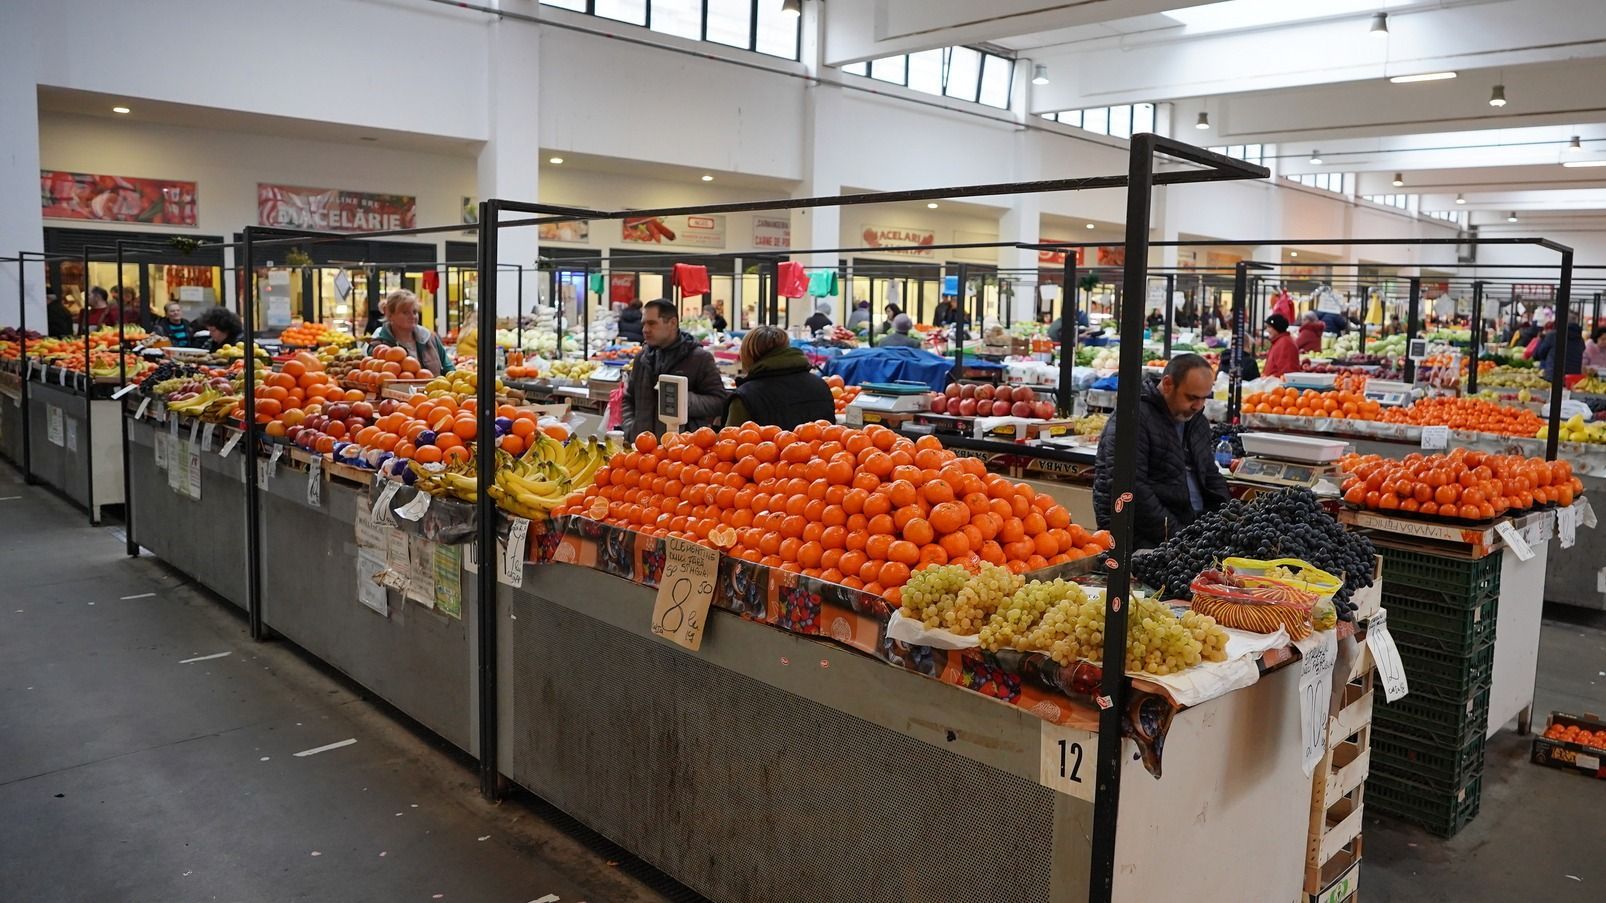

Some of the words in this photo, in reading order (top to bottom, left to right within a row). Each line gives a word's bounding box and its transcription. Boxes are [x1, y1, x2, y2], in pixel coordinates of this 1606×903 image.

[1038, 460, 1079, 474] SAMBA
[661, 578, 693, 634] 8
[697, 580, 713, 595] 50
[1057, 739, 1083, 784] 12
